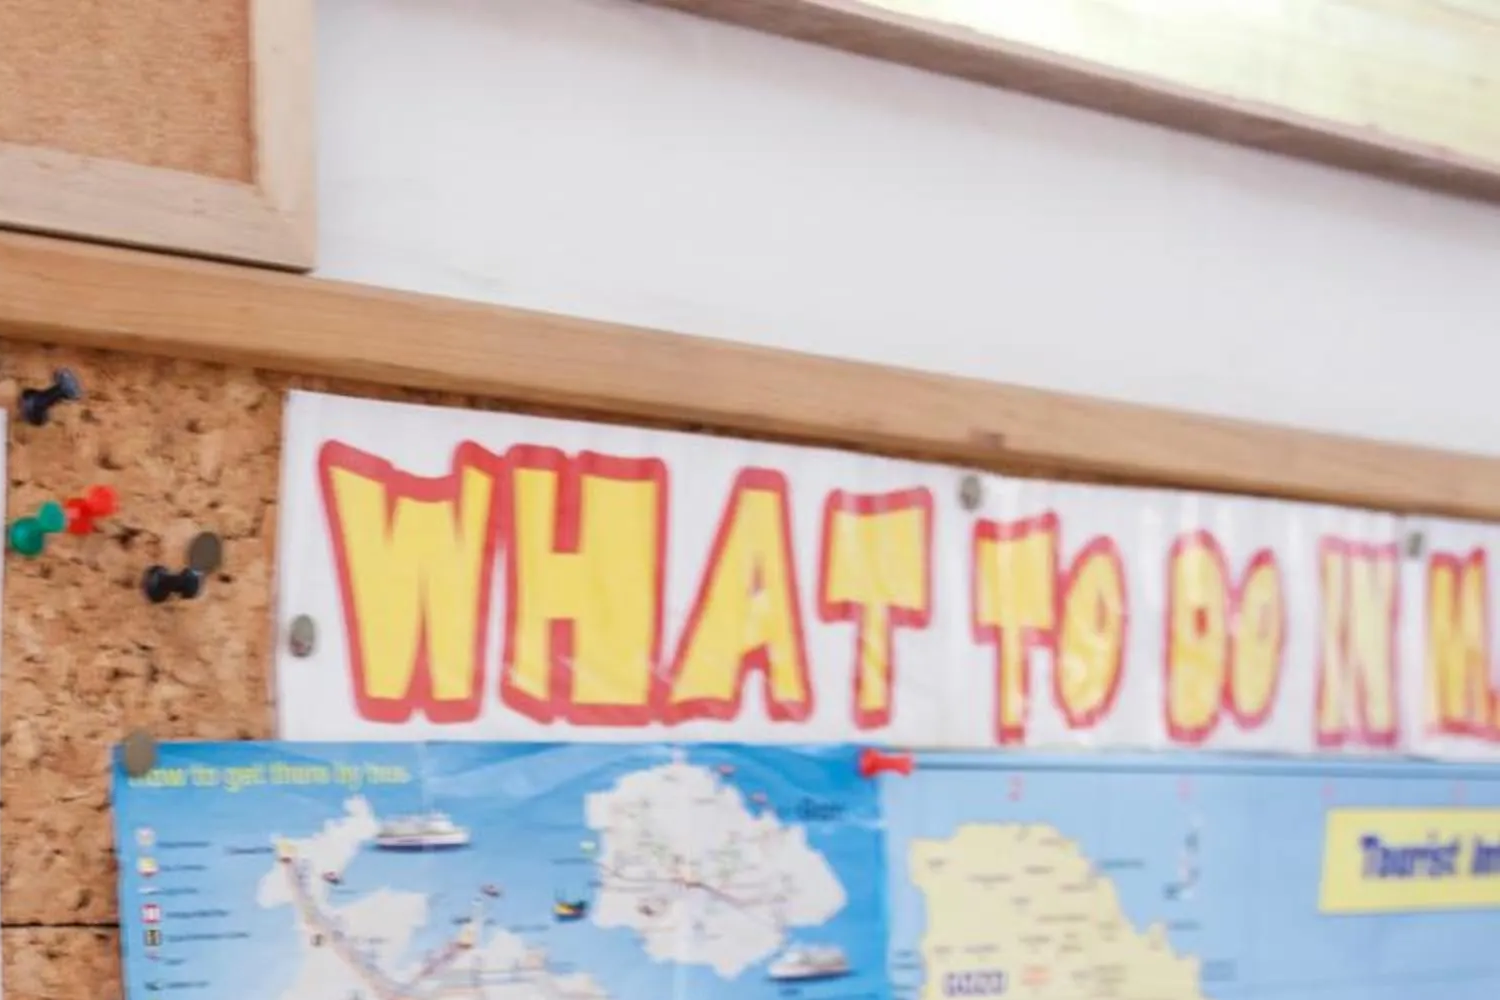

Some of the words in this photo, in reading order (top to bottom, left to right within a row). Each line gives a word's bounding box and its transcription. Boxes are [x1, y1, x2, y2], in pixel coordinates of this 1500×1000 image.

[318, 438, 934, 729] WHAT
[971, 508, 1128, 745] TO
[1162, 529, 1290, 744] DO
[1312, 535, 1400, 748] IN
